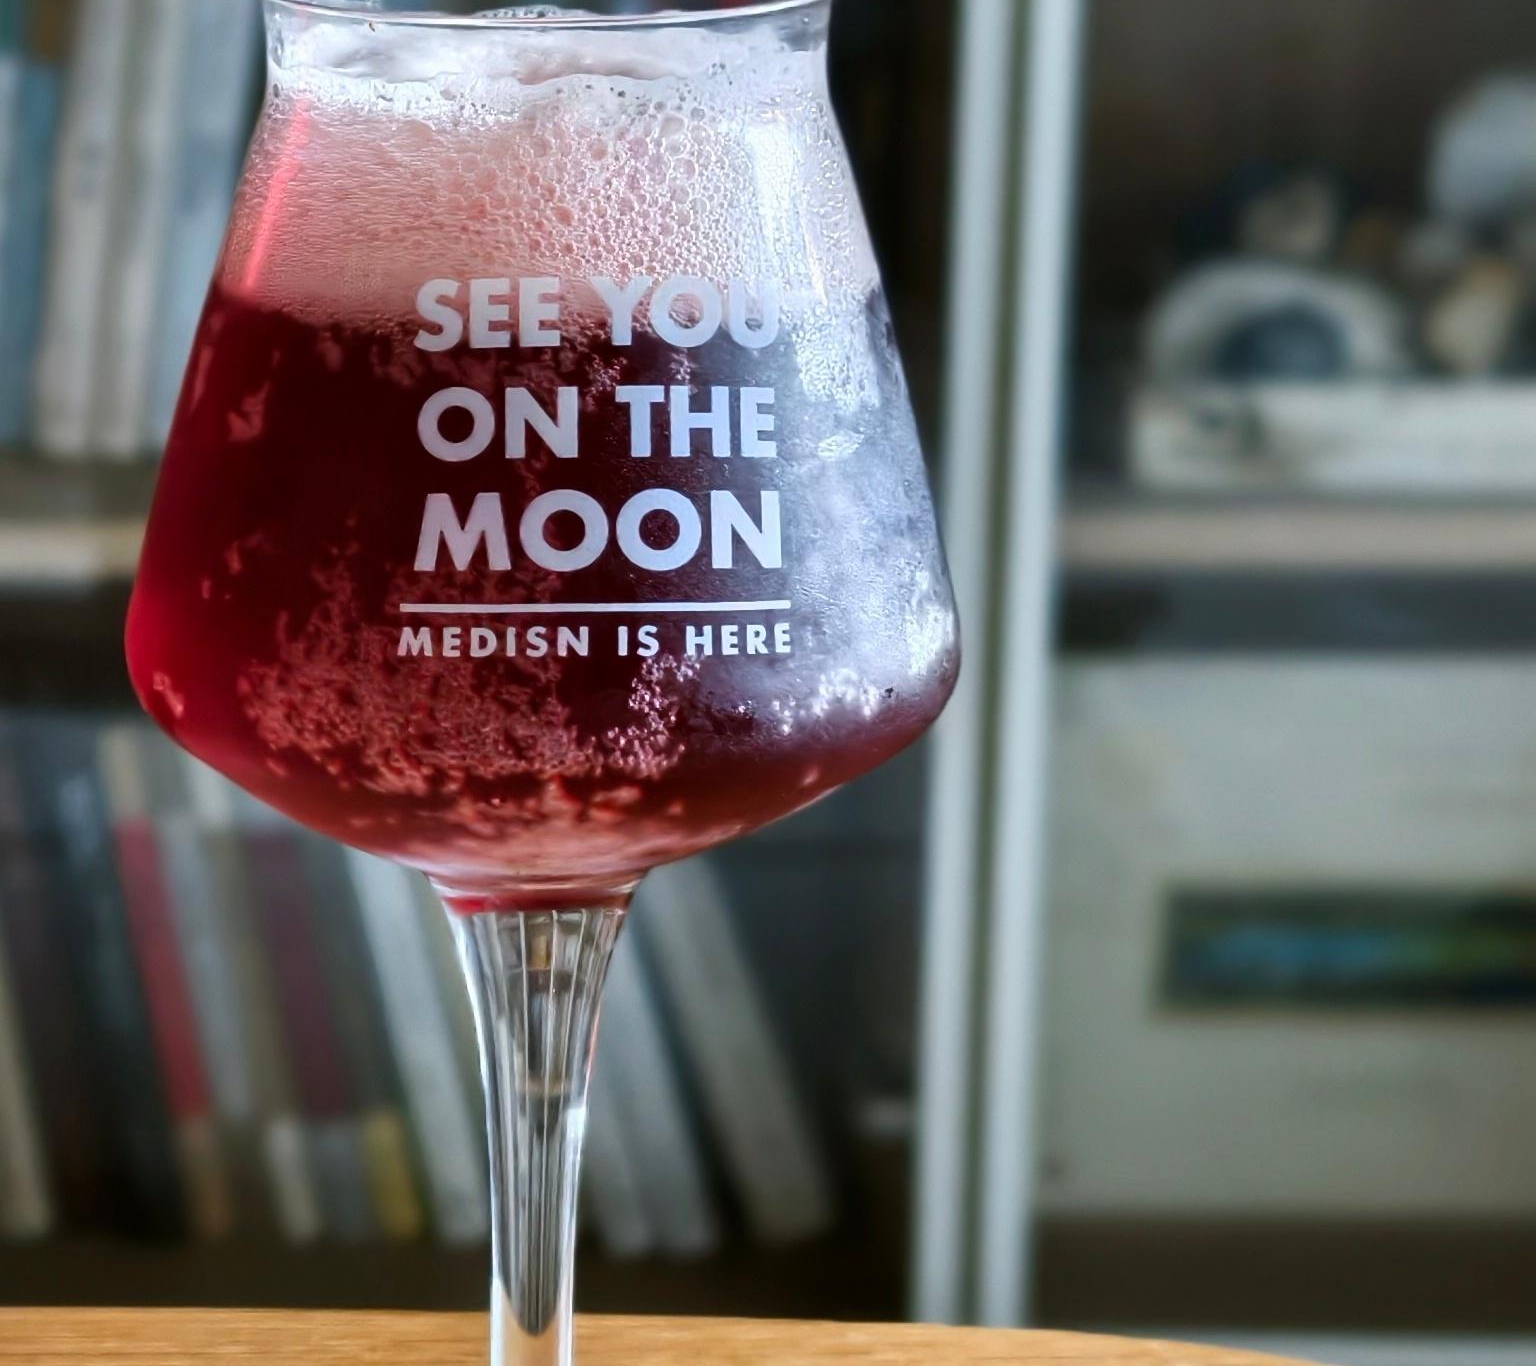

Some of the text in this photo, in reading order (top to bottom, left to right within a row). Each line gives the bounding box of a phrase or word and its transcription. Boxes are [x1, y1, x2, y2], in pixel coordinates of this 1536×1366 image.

[413, 275, 781, 352] SEE YOU
[417, 384, 778, 462] ON THE
[413, 488, 783, 572] MOON
[397, 622, 792, 658] MEDISN IS HERE
